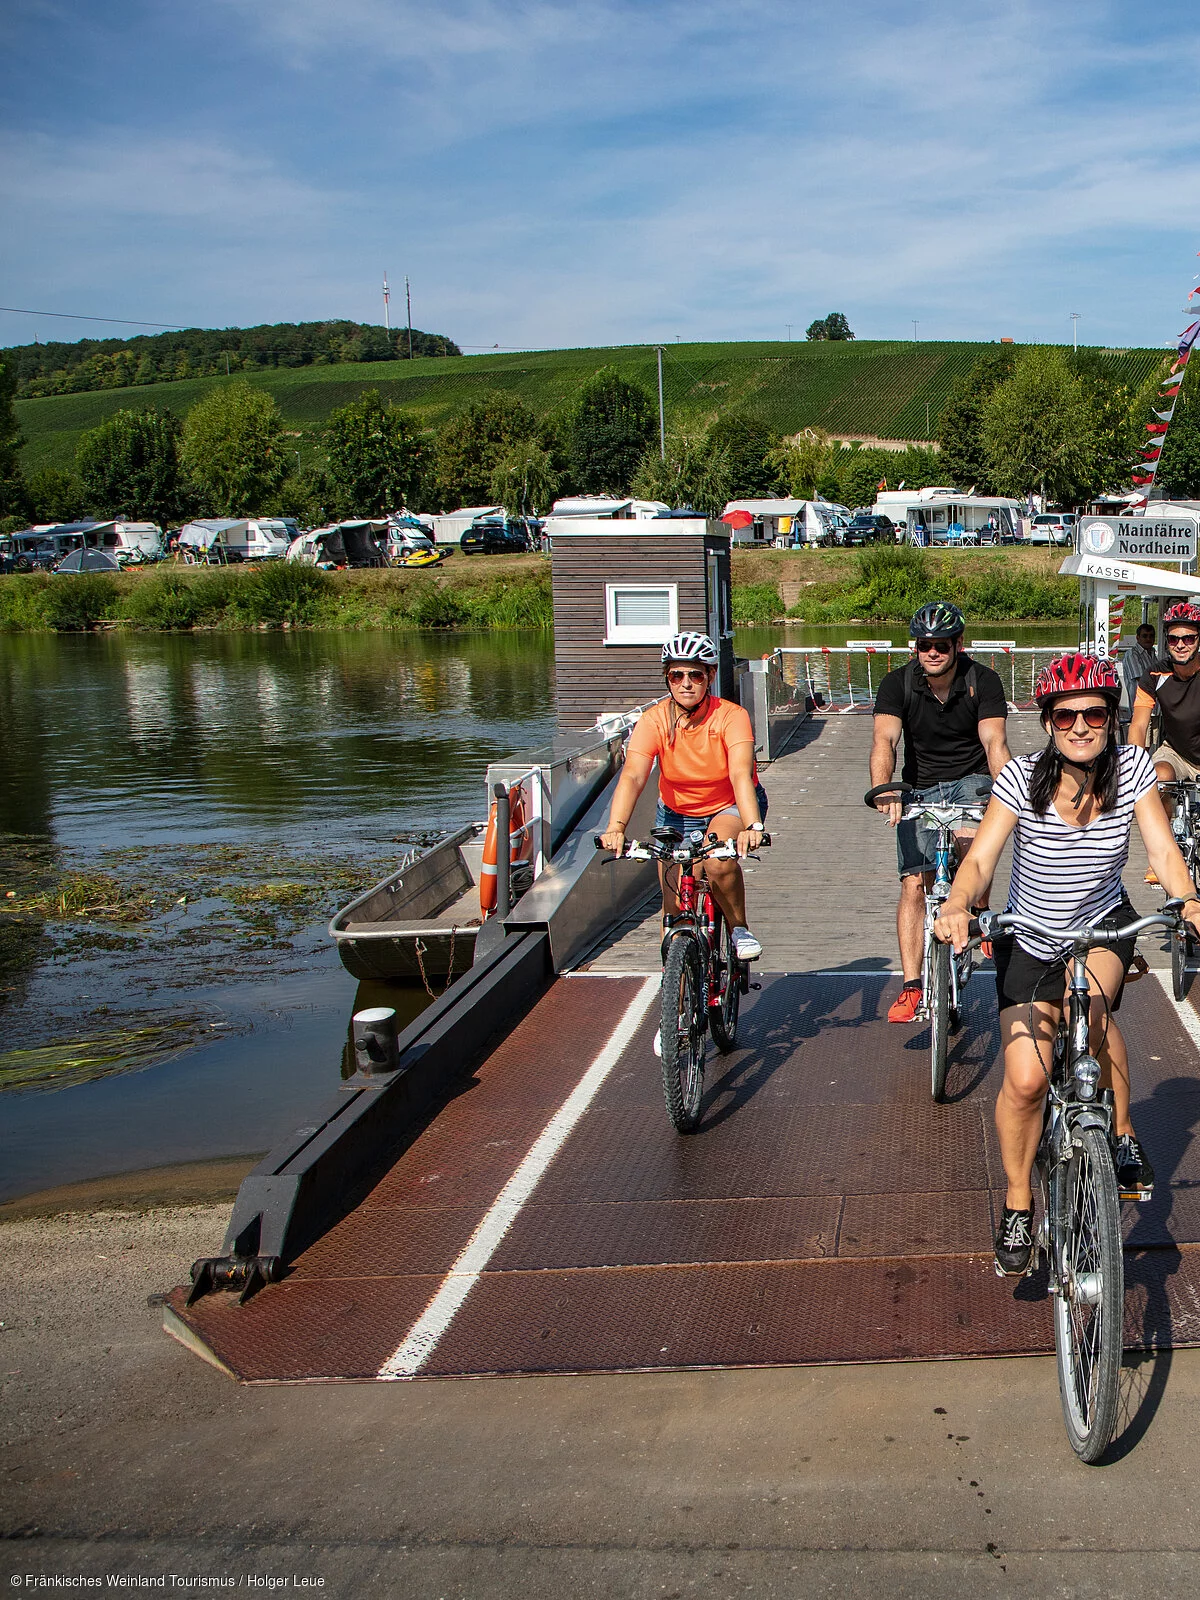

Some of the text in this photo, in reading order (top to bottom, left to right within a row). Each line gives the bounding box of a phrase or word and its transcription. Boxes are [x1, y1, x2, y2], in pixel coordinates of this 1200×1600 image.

[1118, 522, 1192, 538] Mainfähre
[1119, 540, 1190, 555] Nordheim
[1086, 564, 1130, 580] KASSE
